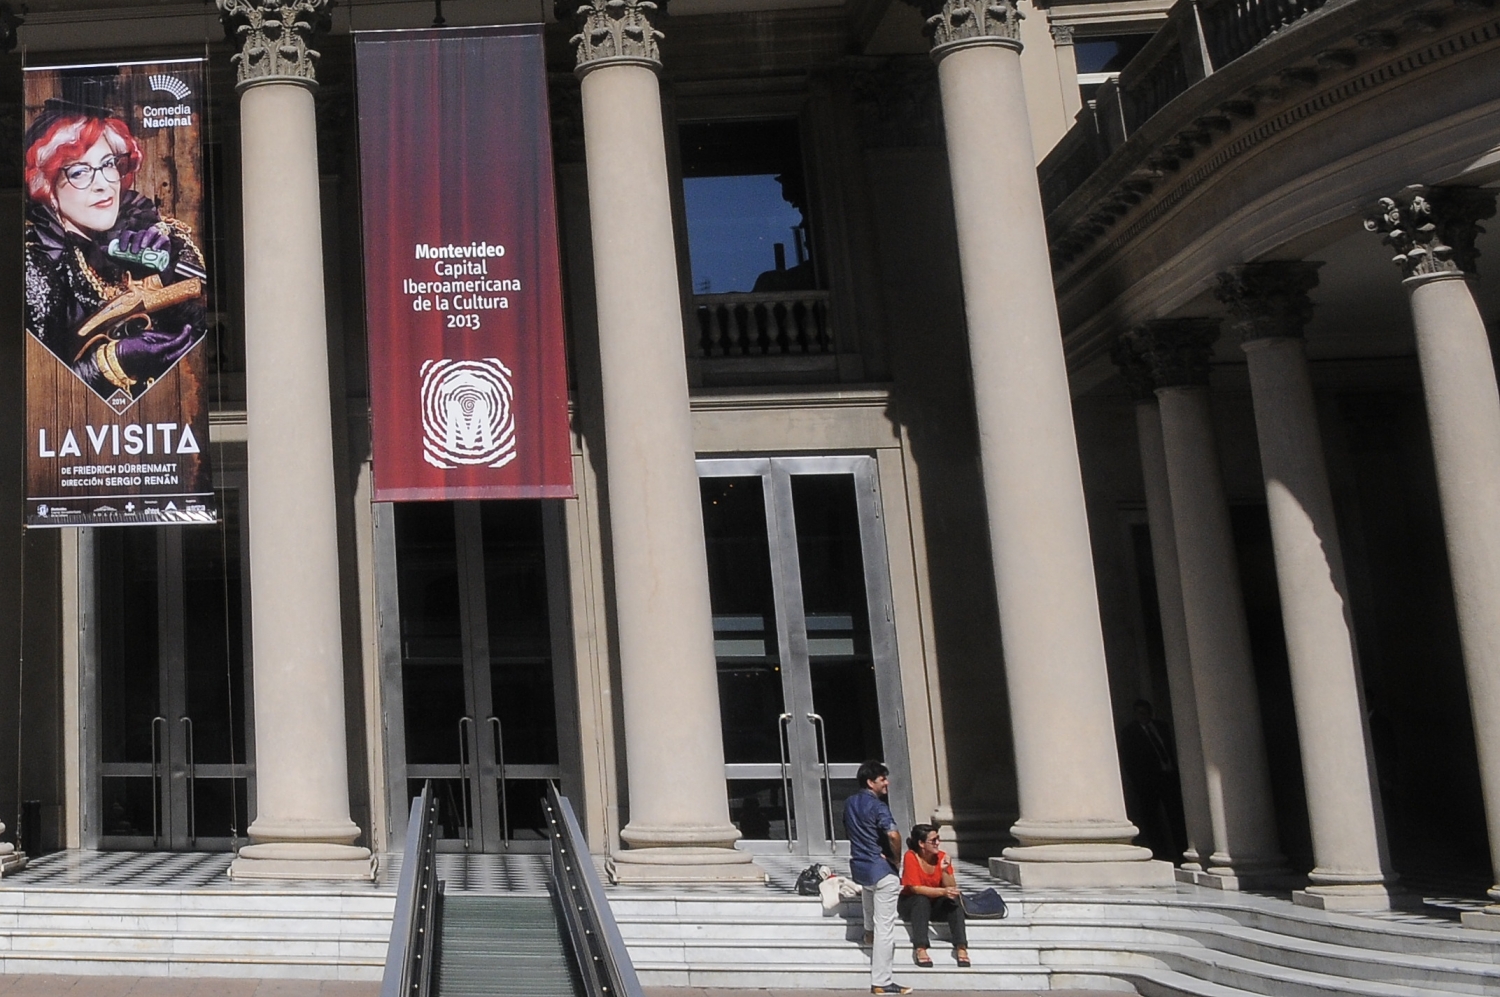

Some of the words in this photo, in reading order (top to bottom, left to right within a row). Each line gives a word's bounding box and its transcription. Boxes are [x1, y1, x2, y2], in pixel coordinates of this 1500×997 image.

[143, 104, 191, 117] Comedia
[143, 115, 192, 128] Nacional
[415, 242, 505, 259] Montevideo
[434, 259, 487, 279] Capital
[403, 277, 521, 294] Iberoamericana
[413, 296, 432, 311] de
[435, 295, 449, 310] la
[453, 294, 509, 309] Cultura
[447, 315, 480, 330] 2013
[39, 429, 81, 458] LA
[86, 422, 201, 456] VISITA
[61, 467, 72, 475] DE
[73, 465, 116, 475] FRIEDRICH
[118, 463, 177, 474] DÜRRENMATT
[61, 477, 103, 487] DIRECCIÓN
[105, 477, 141, 486] SERGIO
